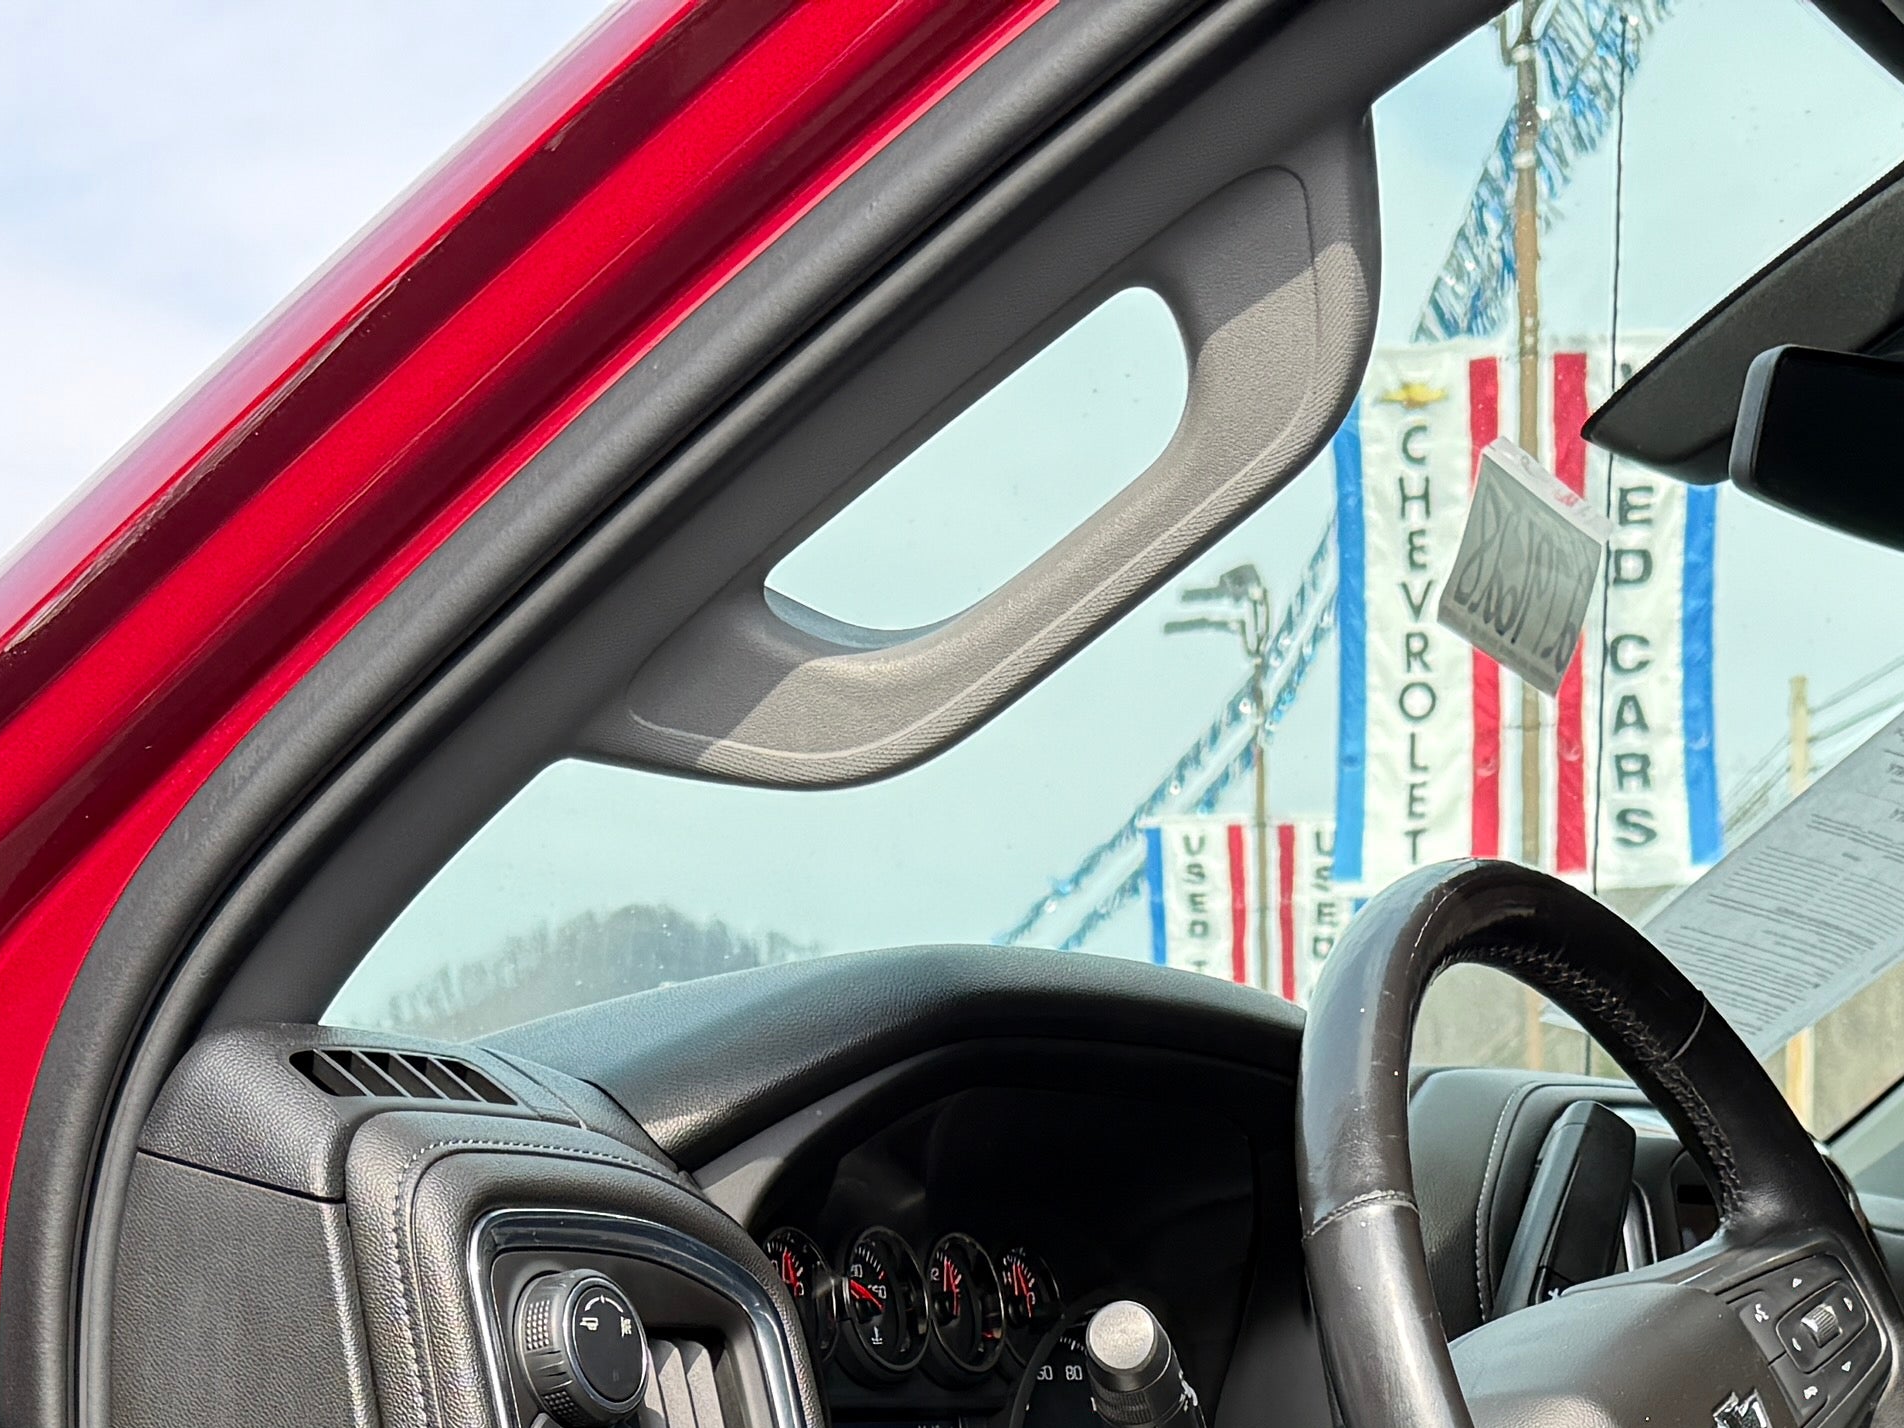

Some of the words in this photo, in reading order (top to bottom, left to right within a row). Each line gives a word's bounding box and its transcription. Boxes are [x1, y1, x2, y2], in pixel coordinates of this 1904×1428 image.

[1398, 424, 1437, 865] CHEVROLET
[1609, 633, 1658, 848] CARS
[1183, 833, 1210, 939] USED
[1311, 830, 1338, 961] USED
